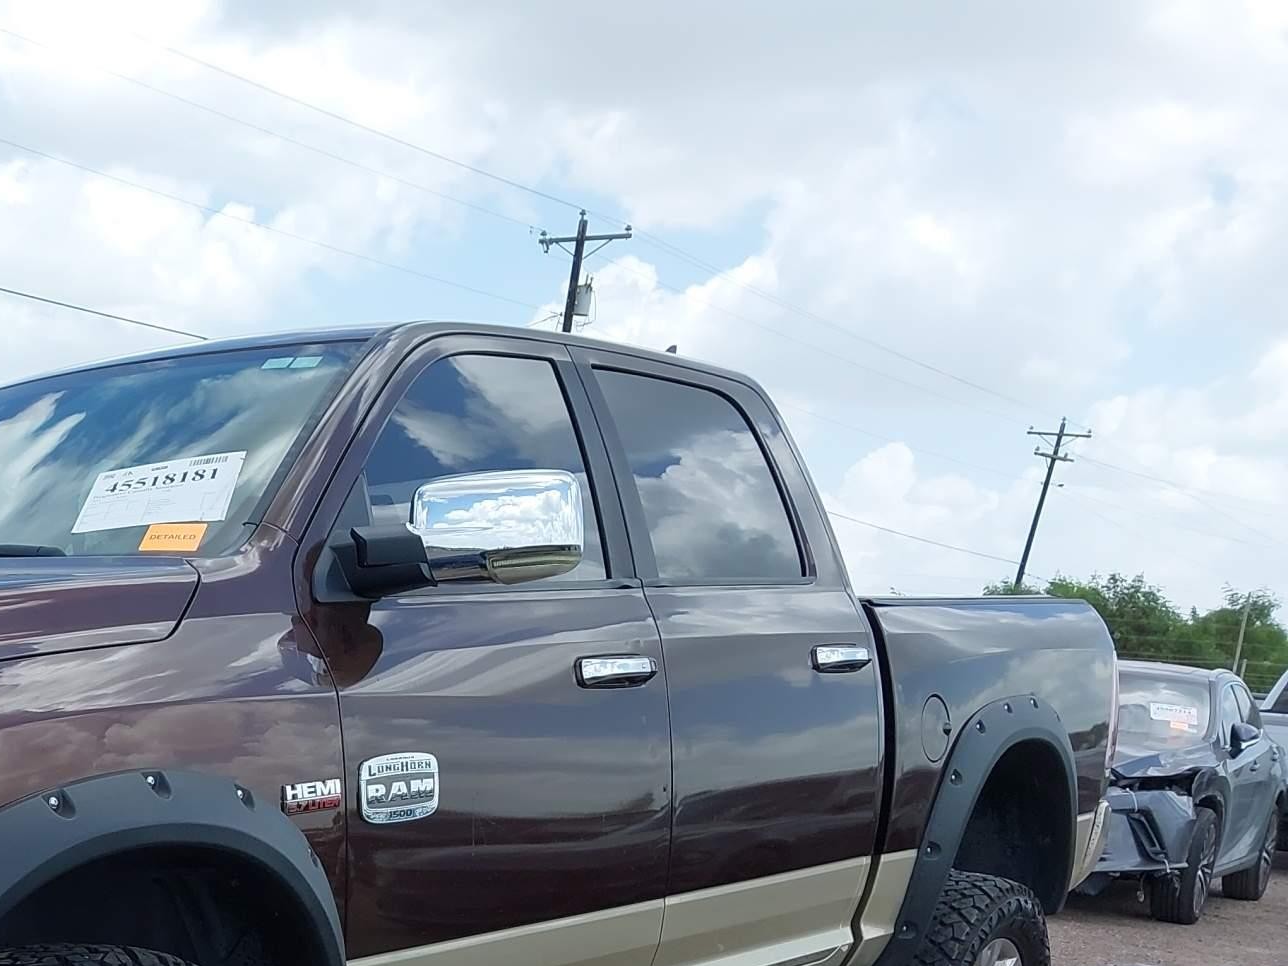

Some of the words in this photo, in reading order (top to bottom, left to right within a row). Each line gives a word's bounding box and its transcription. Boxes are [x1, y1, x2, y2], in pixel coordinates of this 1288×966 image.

[105, 467, 218, 493] 45518181
[148, 533, 197, 542] DETAILED
[285, 778, 342, 801] HEMI
[366, 777, 434, 804] RAM
[389, 808, 413, 819] 1500
